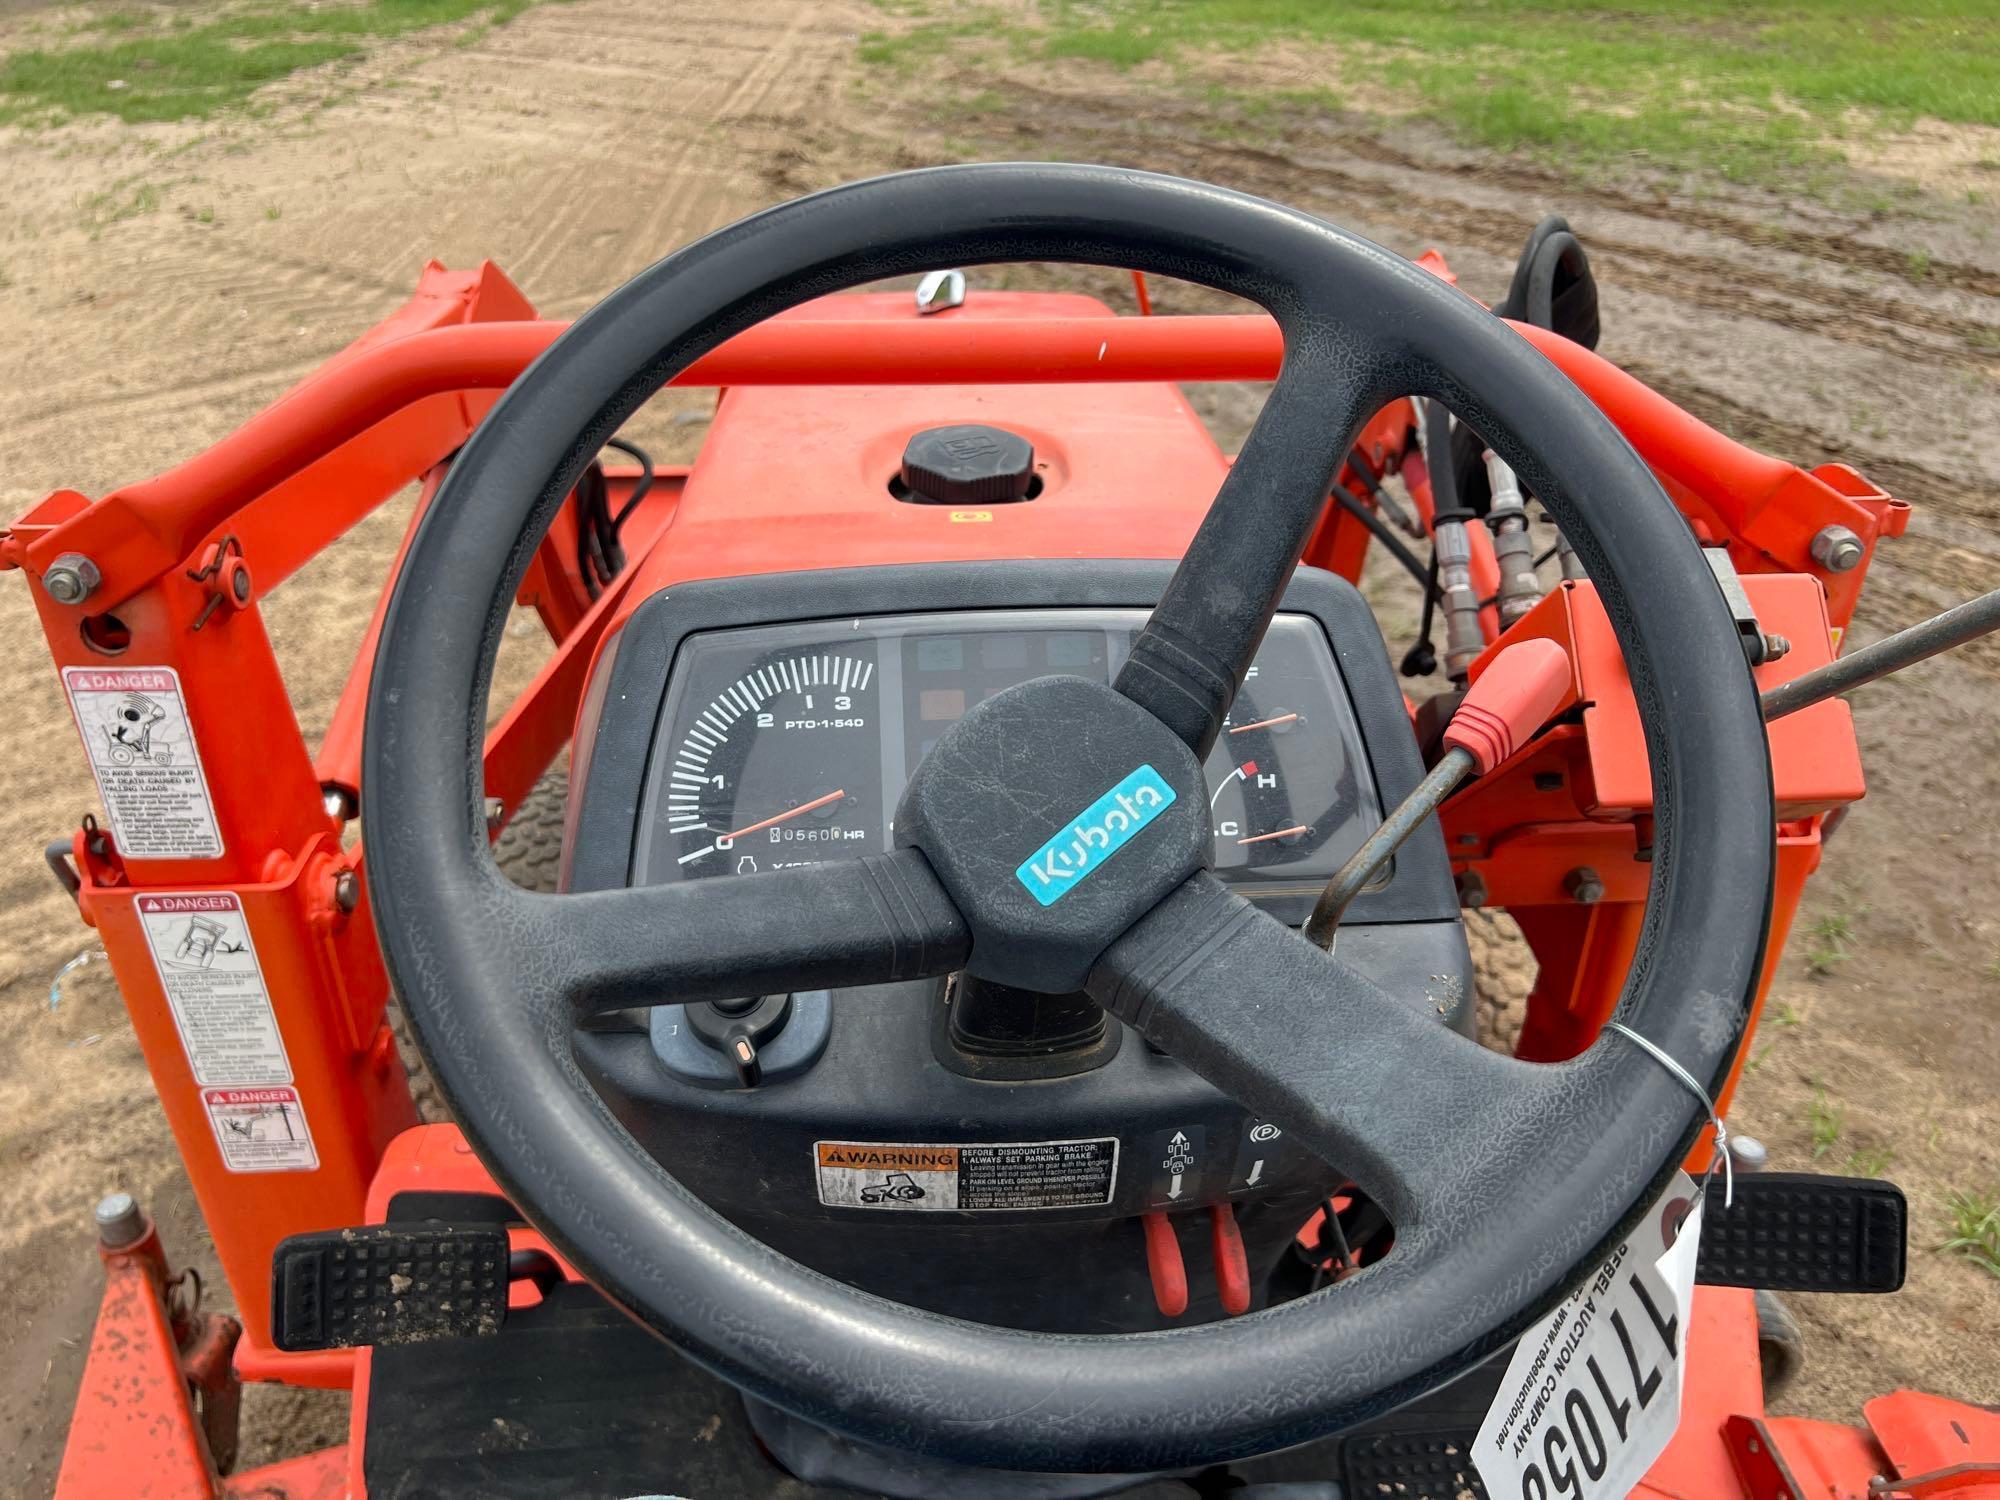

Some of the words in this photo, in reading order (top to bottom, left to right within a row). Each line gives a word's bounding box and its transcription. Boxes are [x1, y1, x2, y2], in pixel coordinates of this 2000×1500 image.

[92, 674, 166, 688] DANGER
[834, 696, 851, 710] 3
[756, 713, 774, 728] 2
[711, 775, 724, 789] 1
[1258, 774, 1276, 788] H
[844, 829, 865, 840] HR
[1030, 785, 1163, 885] Kubota
[162, 897, 232, 910] DANGER
[229, 1091, 290, 1102] DANGER
[998, 1147, 1054, 1156] DISMOUNTING
[1058, 1144, 1098, 1153] TRACTOR:
[847, 1151, 953, 1166] WARNING
[970, 1156, 1002, 1164] ALWAYS
[1005, 1155, 1020, 1163] SET
[1025, 1154, 1060, 1162] PARKING
[970, 1164, 996, 1172] Leaving
[1046, 1162, 1060, 1170] gear
[1553, 1296, 1596, 1377] AUCTION
[1496, 1308, 1568, 1451] www.rebelauction.net
[1513, 1375, 1556, 1459] COMPANY
